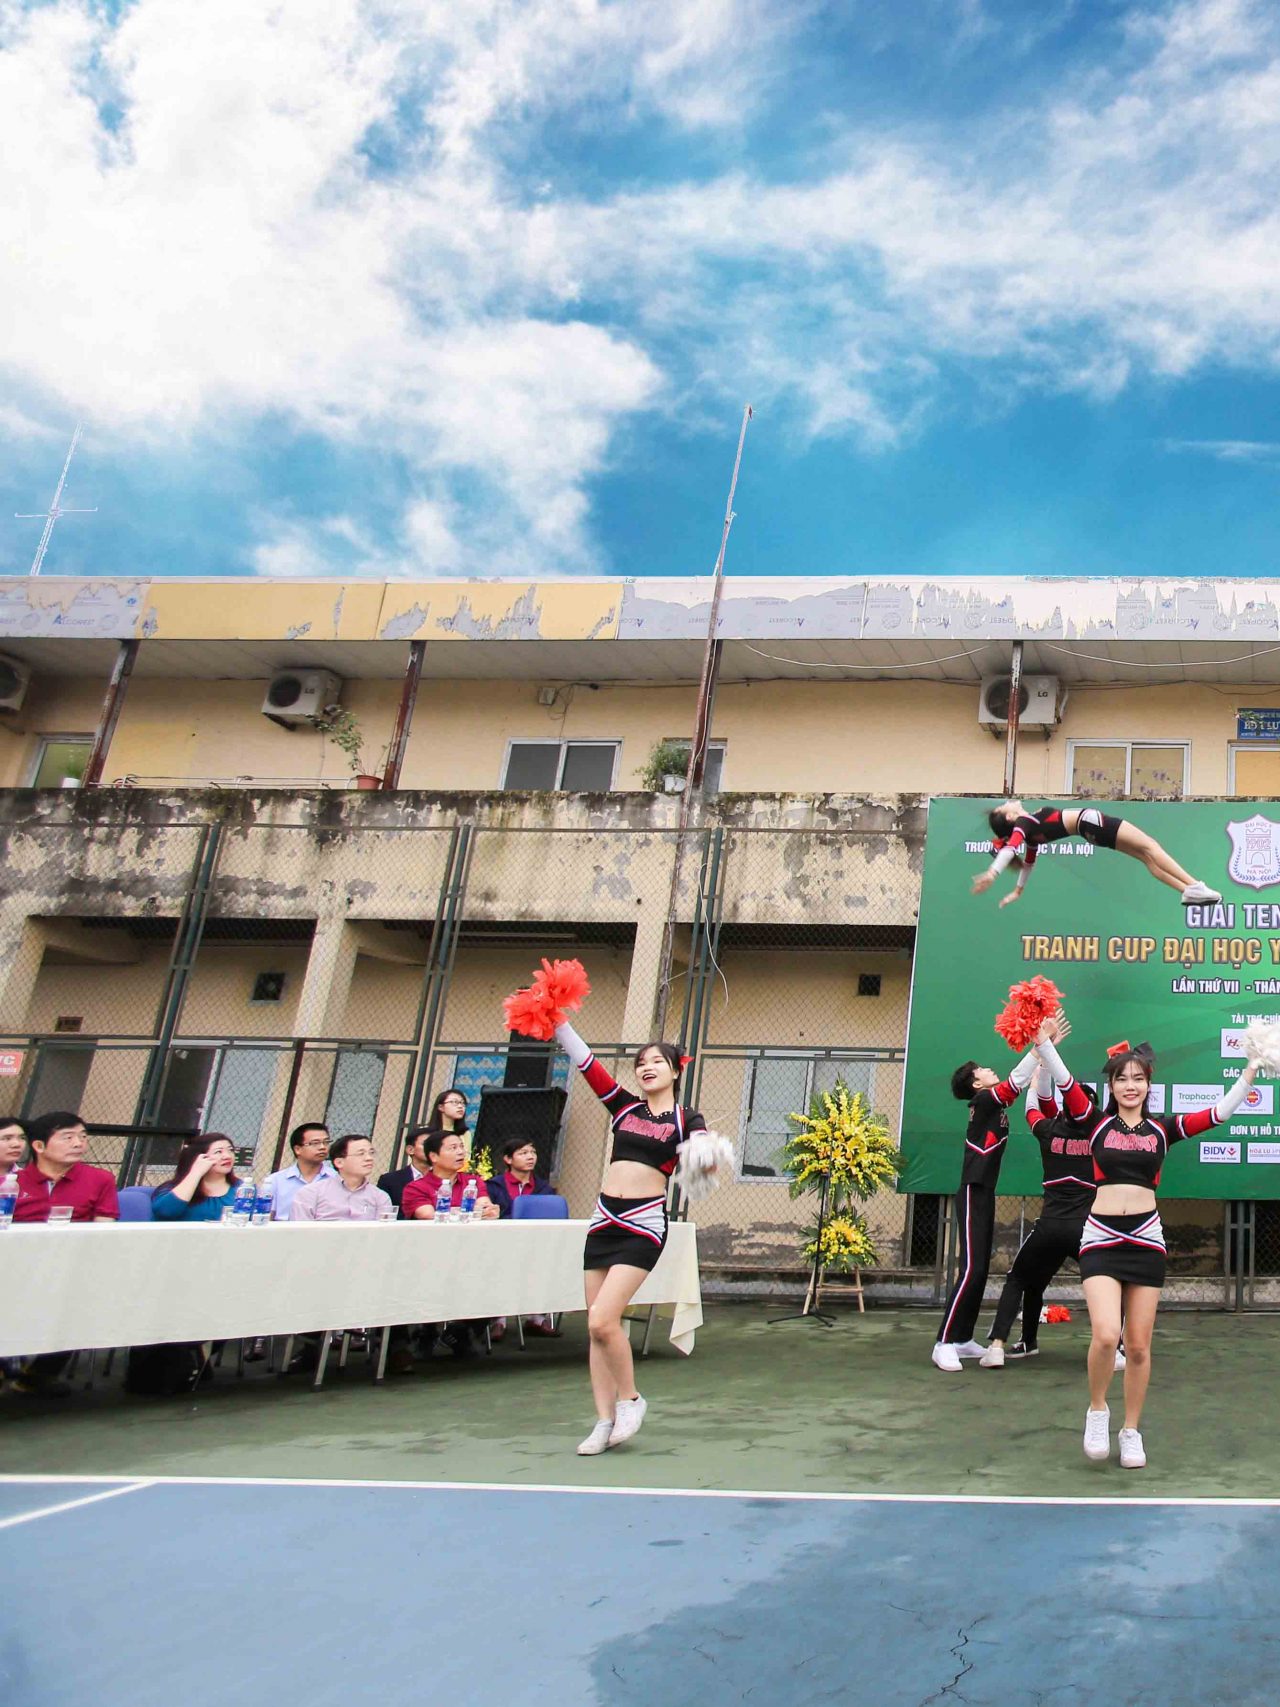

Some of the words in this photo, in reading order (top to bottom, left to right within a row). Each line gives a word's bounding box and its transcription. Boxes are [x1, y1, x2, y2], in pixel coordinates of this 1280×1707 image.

[1051, 843, 1058, 854] Y
[1059, 842, 1073, 855] HÀ
[1075, 842, 1094, 857] NỘI
[1021, 936, 1100, 961] TRANH
[1107, 937, 1156, 962] CUP
[1164, 938, 1205, 968] ĐẠI
[1212, 938, 1261, 969] HỌC
[1172, 976, 1195, 993] LẦN
[1198, 978, 1222, 993] THỨ
[1224, 980, 1239, 993] VII
[1223, 1067, 1240, 1078] CÁC
[1178, 1092, 1217, 1102] Traphaco
[1230, 1125, 1248, 1135] ĐƠN
[1250, 1125, 1258, 1137] VỊ
[1203, 1146, 1227, 1156] BIDV
